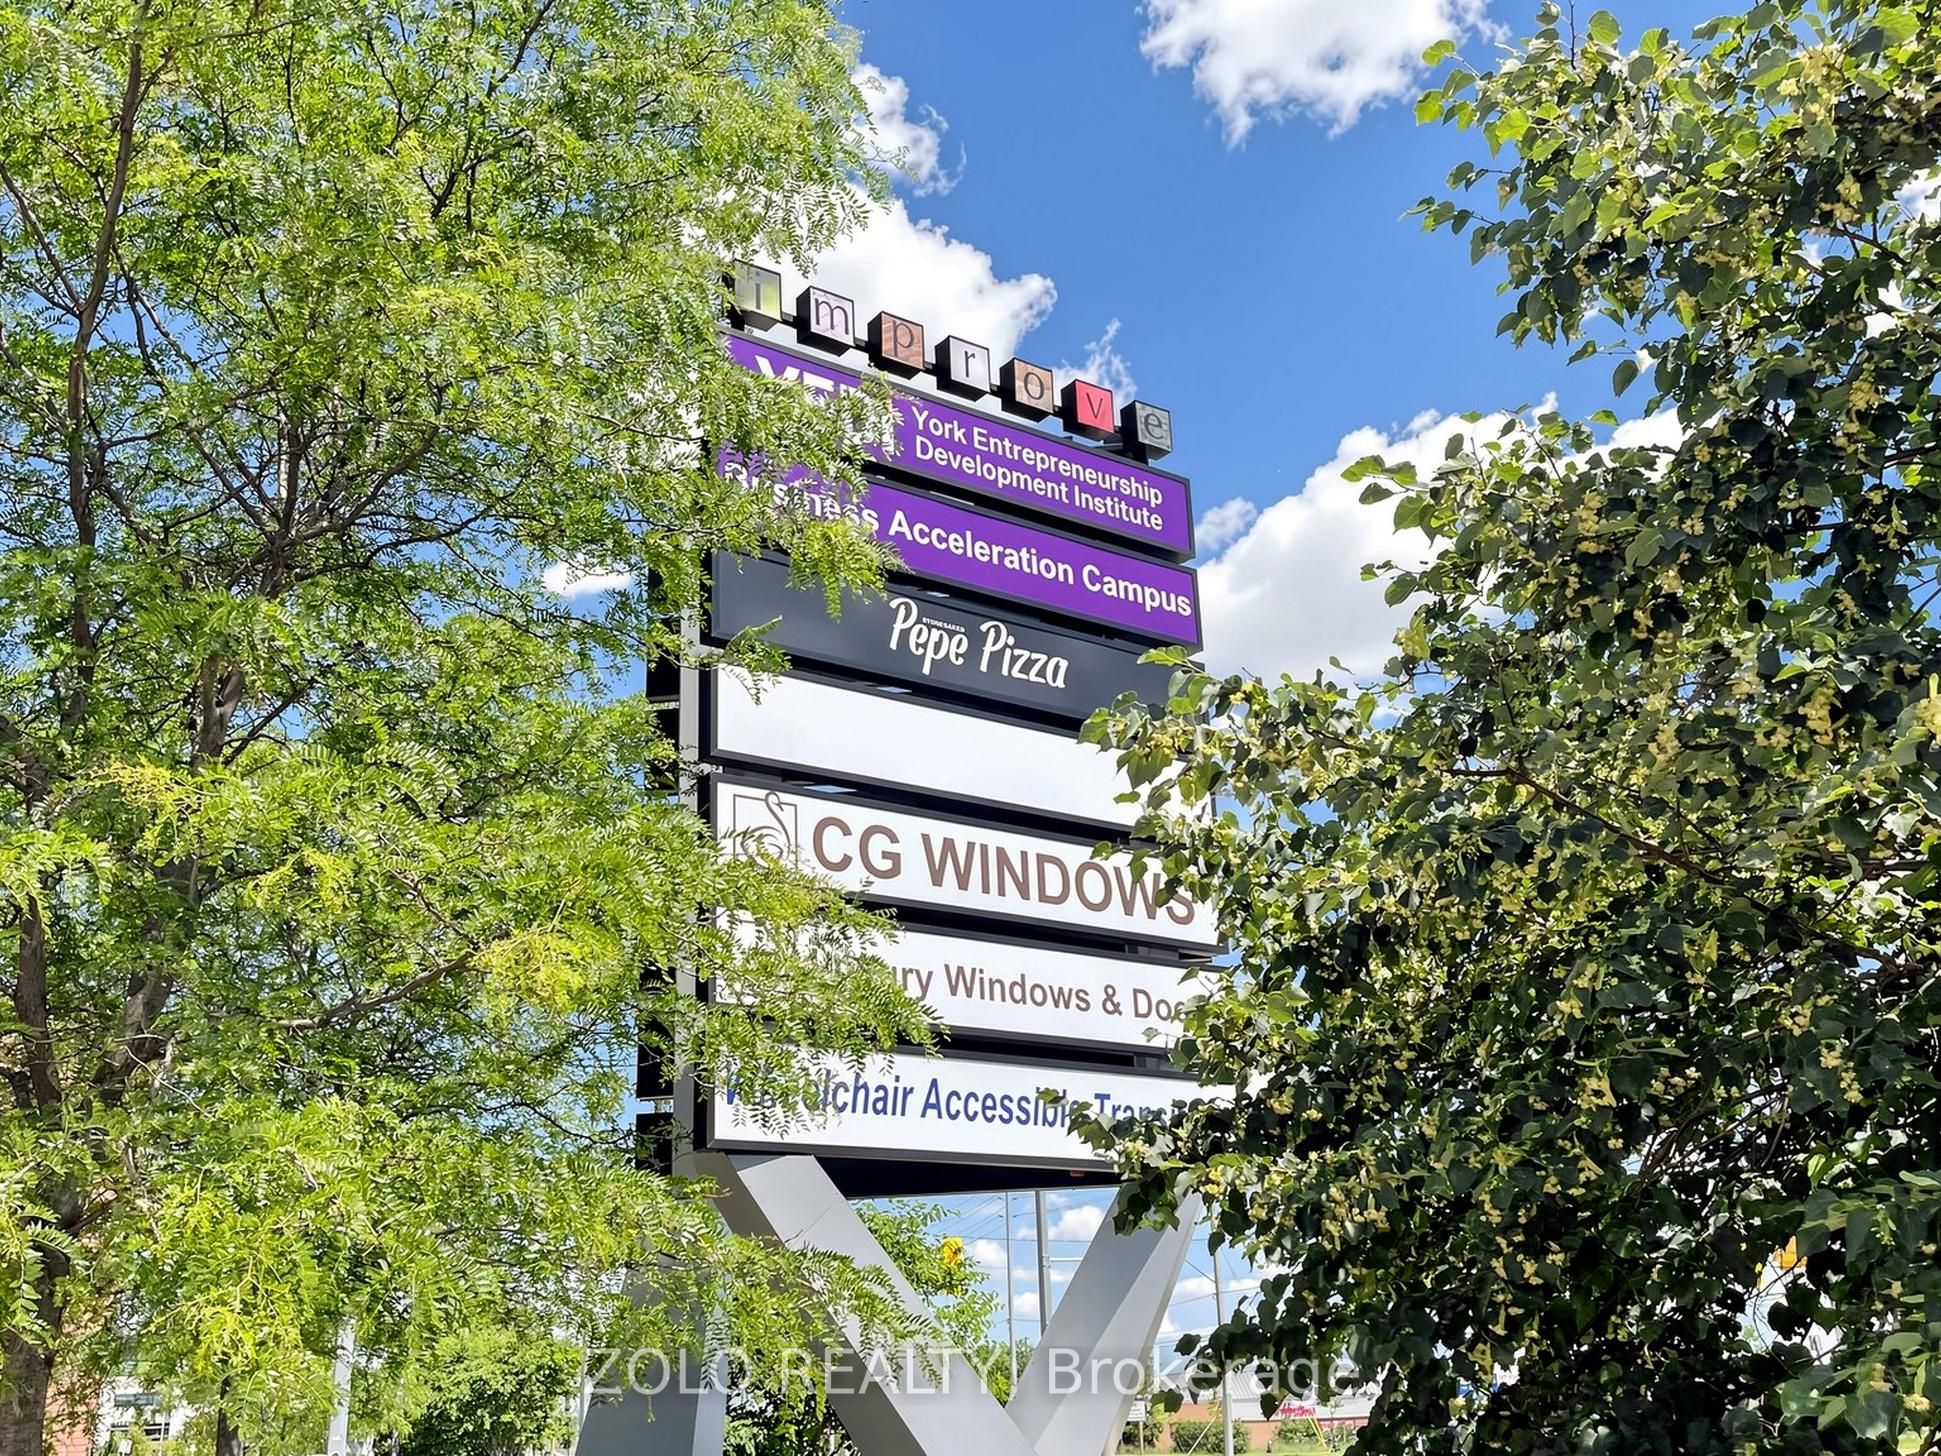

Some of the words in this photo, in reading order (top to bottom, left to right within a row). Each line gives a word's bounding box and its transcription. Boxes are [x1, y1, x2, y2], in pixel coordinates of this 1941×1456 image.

[912, 405, 967, 445] York
[973, 427, 1163, 508] Entrepreneurship
[915, 435, 1069, 503] Development
[1075, 485, 1163, 531] Institute
[889, 510, 1075, 585] Acceleration
[1082, 563, 1193, 617] Campus
[889, 597, 969, 676] Pepe
[979, 620, 1070, 688] Pizza
[812, 816, 902, 880] CG
[920, 833, 1196, 926] WINDOWS
[944, 963, 1091, 1012] Windows
[1102, 984, 1123, 1016] &
